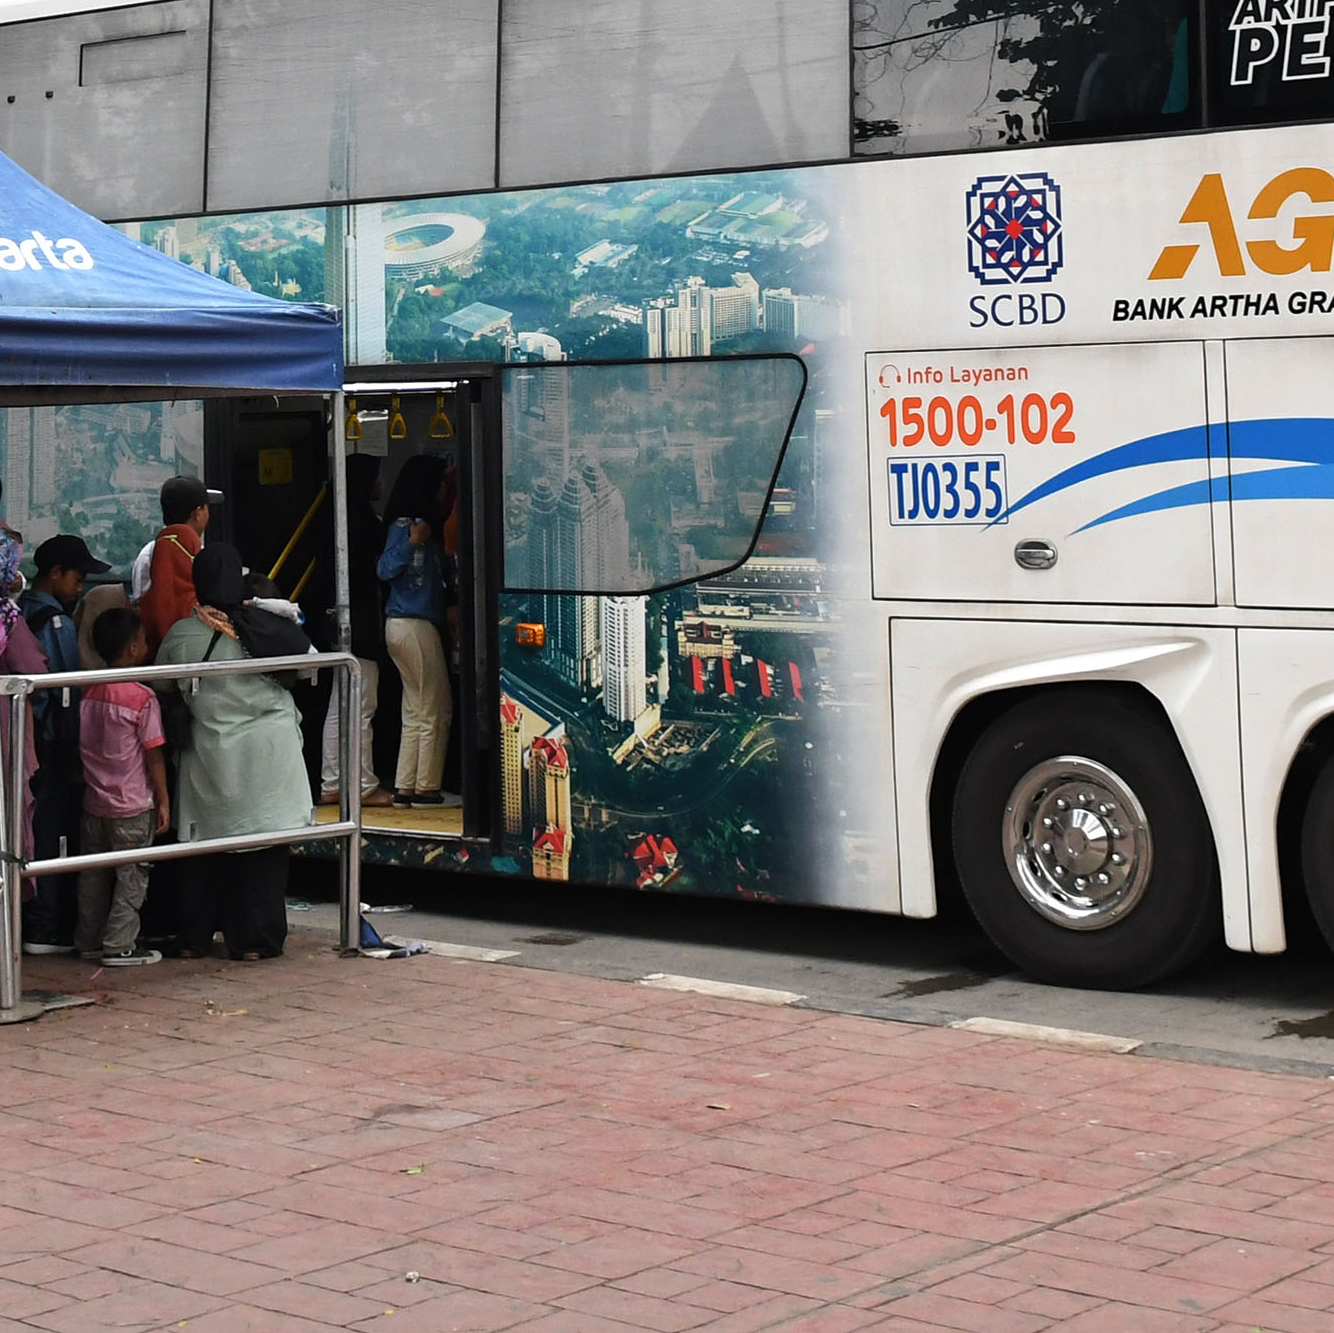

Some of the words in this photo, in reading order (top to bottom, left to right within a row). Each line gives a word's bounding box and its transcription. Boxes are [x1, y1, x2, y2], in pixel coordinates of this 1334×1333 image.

[969, 292, 1067, 329] SCBD
[1112, 296, 1186, 322] BANK
[1190, 292, 1280, 319] ARTHA
[906, 365, 944, 385] Info
[949, 363, 1029, 387] Layanan
[879, 391, 1077, 448] 1500-102
[889, 460, 1003, 522] TJ0355
